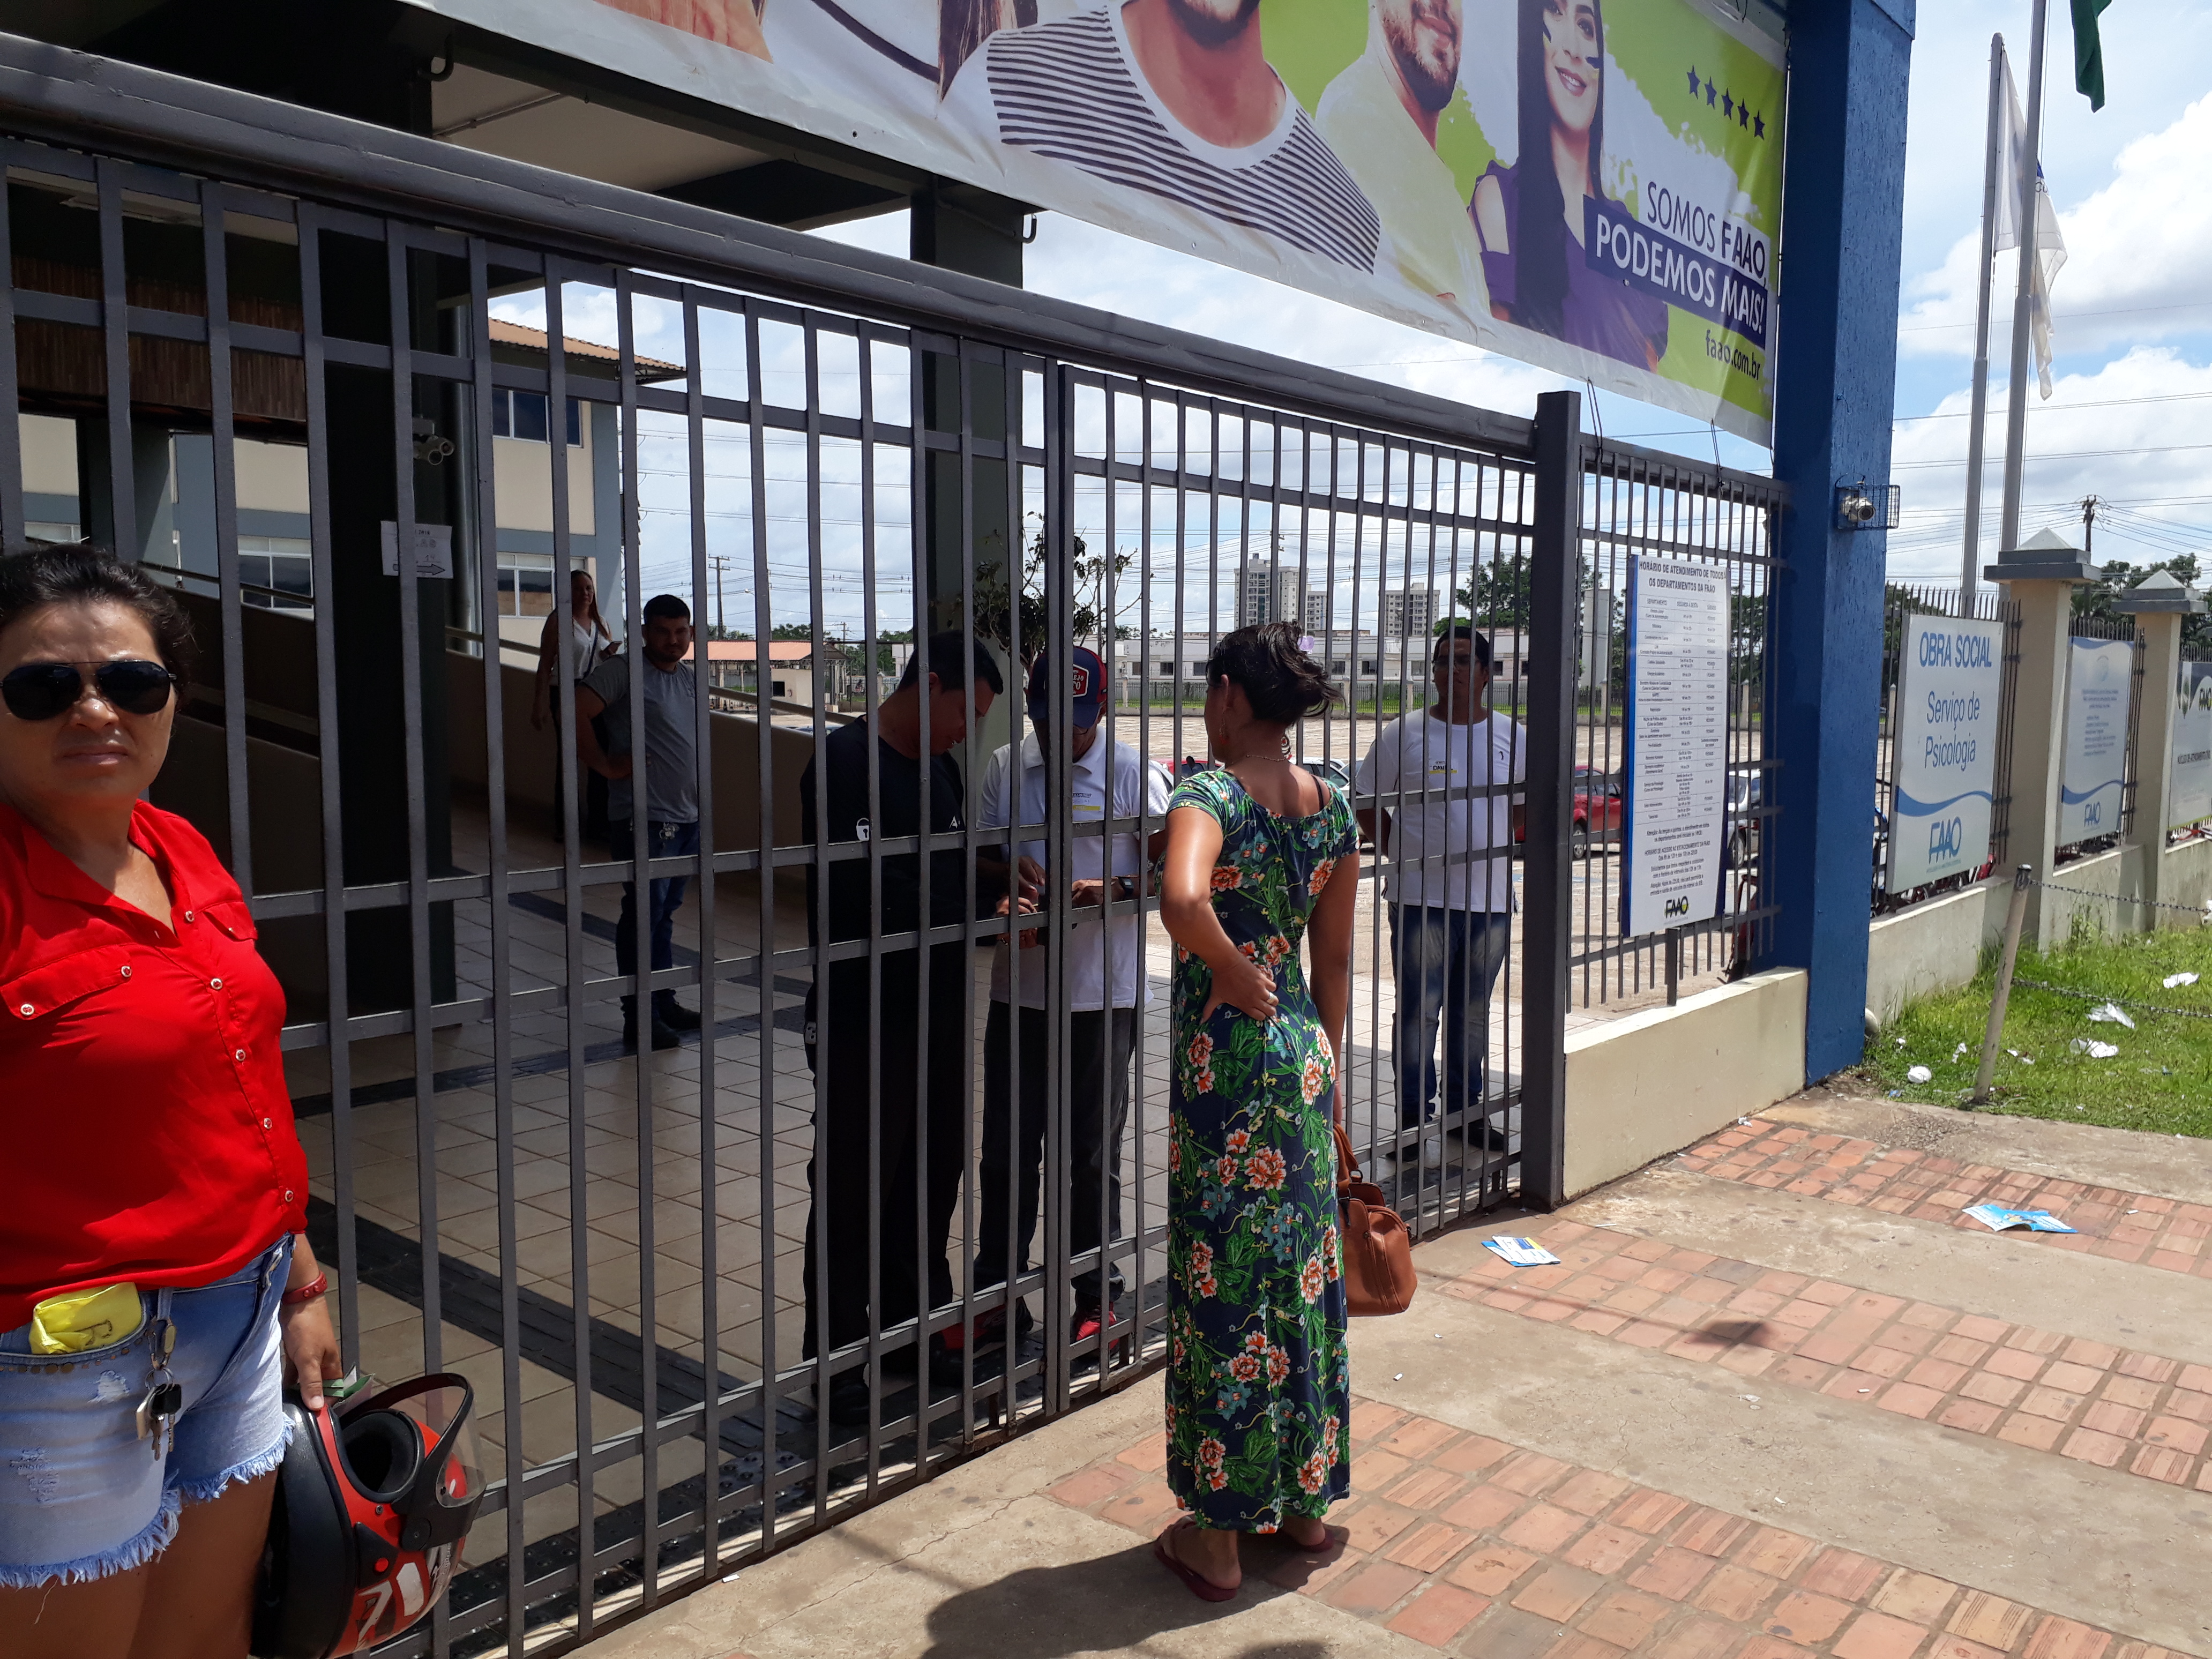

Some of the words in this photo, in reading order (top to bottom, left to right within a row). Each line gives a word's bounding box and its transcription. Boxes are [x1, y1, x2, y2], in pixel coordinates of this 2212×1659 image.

[1647, 182, 1715, 253] SOMOS
[1596, 214, 1715, 308] PODEMOS
[1721, 274, 1764, 333] MAIS!
[1706, 329, 1761, 381] faao.com.br
[1639, 561, 1661, 572] HORÁRIO
[1663, 564, 1669, 573] DE
[1670, 565, 1702, 577] ATENDIMENTO
[1703, 570, 1709, 578] DE
[1649, 578, 1655, 587] OS
[1657, 579, 1696, 591] DEPARTAMENTOS
[1919, 631, 1952, 668] OBRA
[1955, 634, 1992, 668] SOCIAL
[1927, 691, 1965, 730] Serviço
[1967, 690, 1980, 721] de
[1925, 735, 1977, 772] Psicologia
[2084, 802, 2101, 827] FAAO
[1929, 816, 1962, 864] FAAO
[1665, 896, 1688, 918] FAAO
